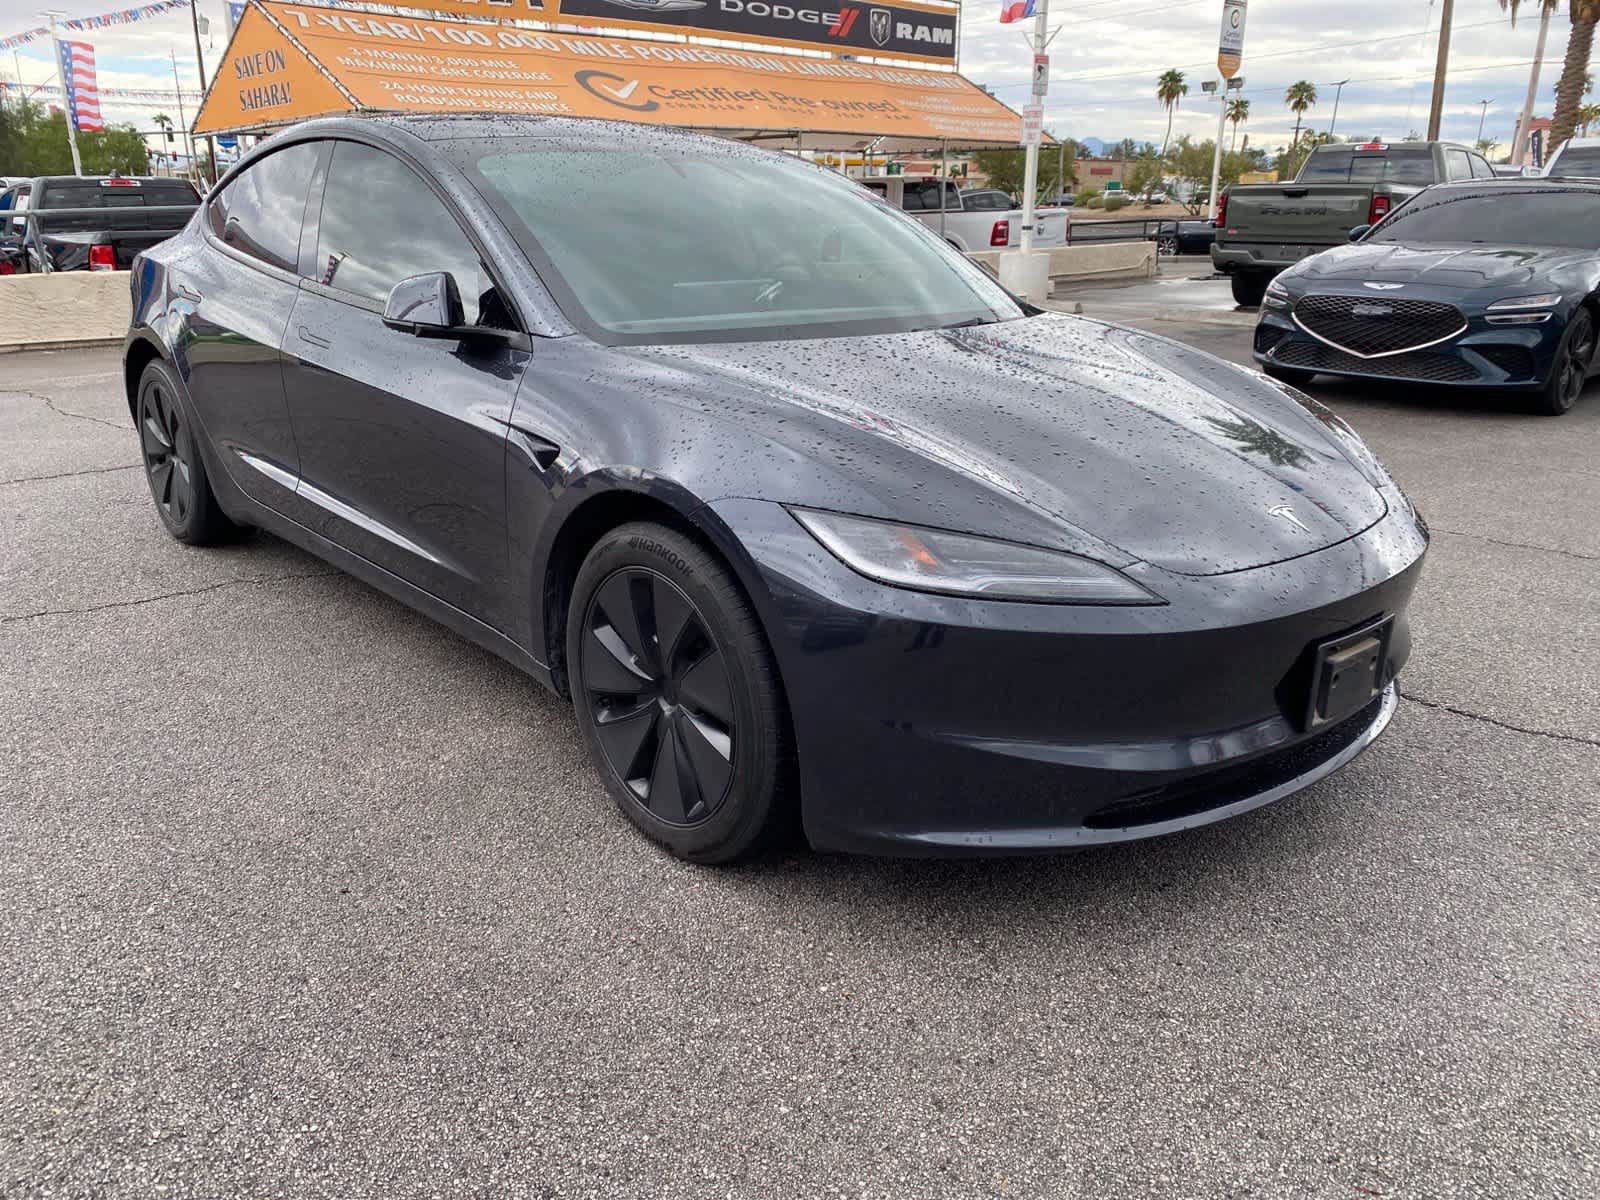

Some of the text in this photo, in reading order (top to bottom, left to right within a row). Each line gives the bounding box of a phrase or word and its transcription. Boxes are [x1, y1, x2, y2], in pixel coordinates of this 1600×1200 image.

[720, 0, 841, 26] DODGE
[896, 22, 953, 44] RAM
[234, 49, 286, 80] SAVE ON
[560, 38, 635, 60] MILE
[632, 45, 792, 73] POWERTRAIN
[790, 60, 874, 80] LIMITED
[239, 81, 292, 112] SAHARA!
[647, 84, 769, 101] Certified
